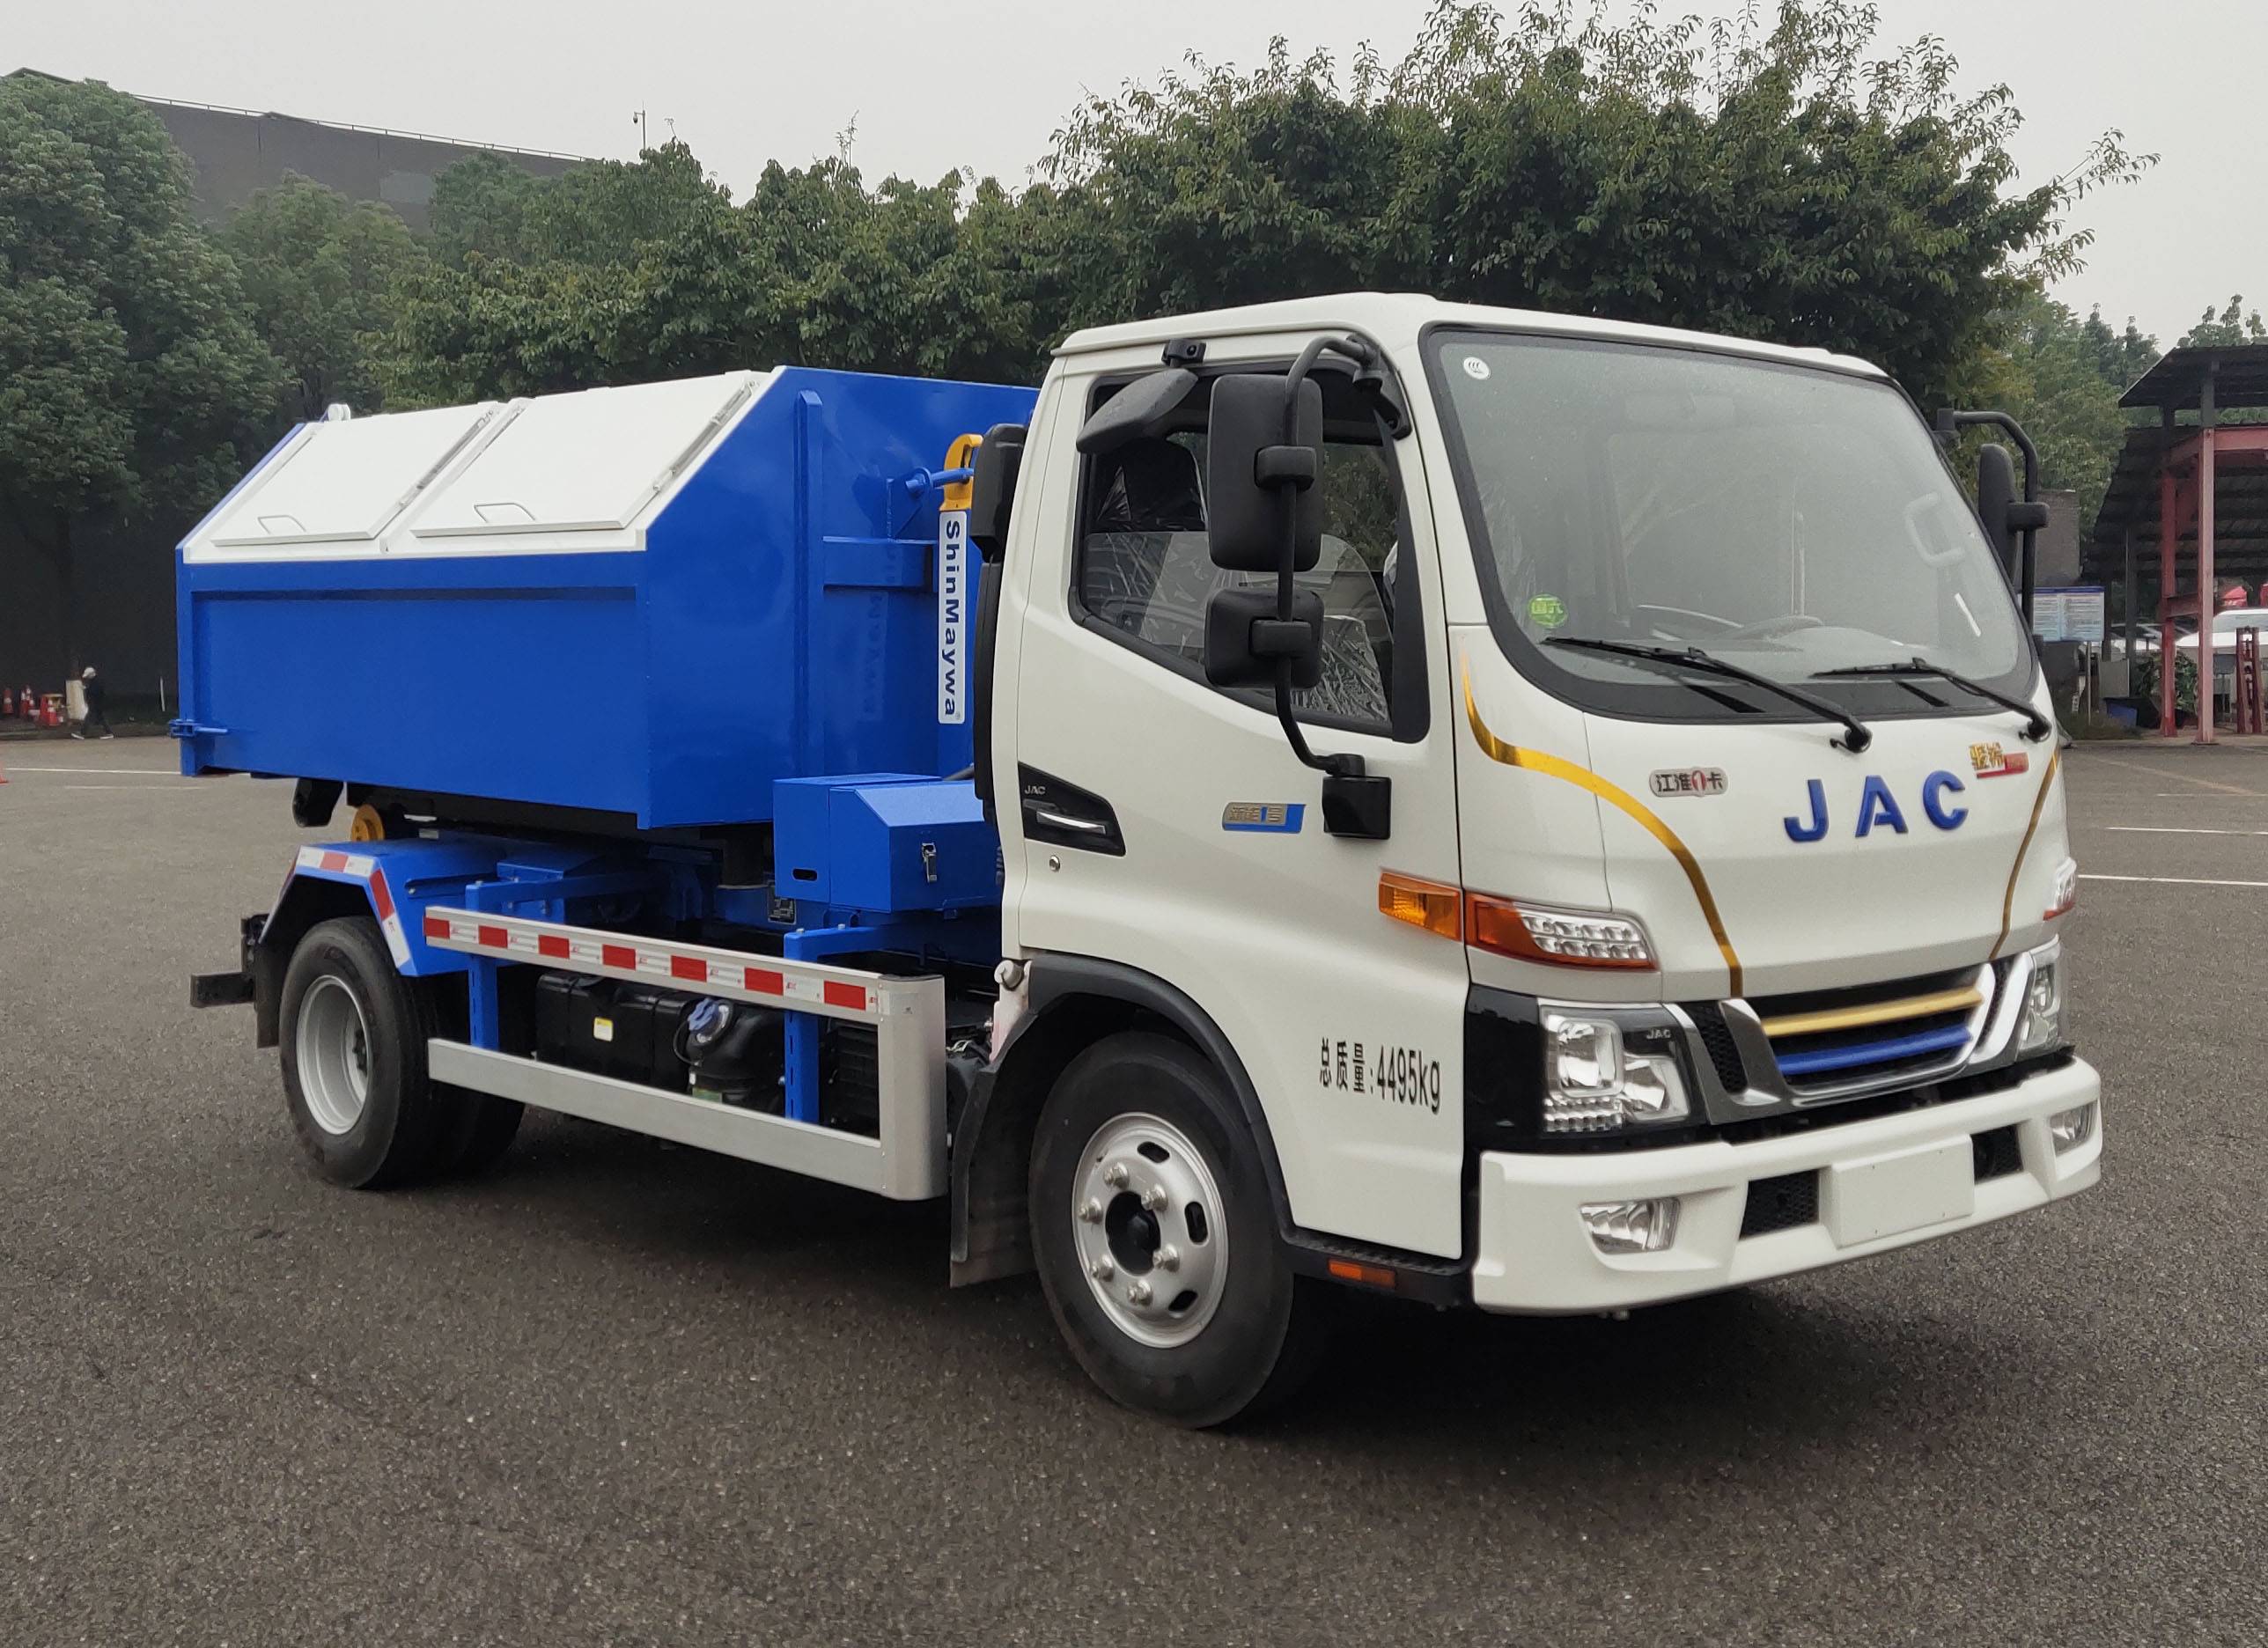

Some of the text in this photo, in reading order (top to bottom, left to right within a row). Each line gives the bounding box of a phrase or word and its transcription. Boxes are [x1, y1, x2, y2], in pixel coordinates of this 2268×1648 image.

[942, 520, 960, 716] ShinMaywa
[1024, 784, 1046, 795] JAC
[1784, 769, 1969, 843] JAC
[1646, 1027, 1671, 1040] JAC
